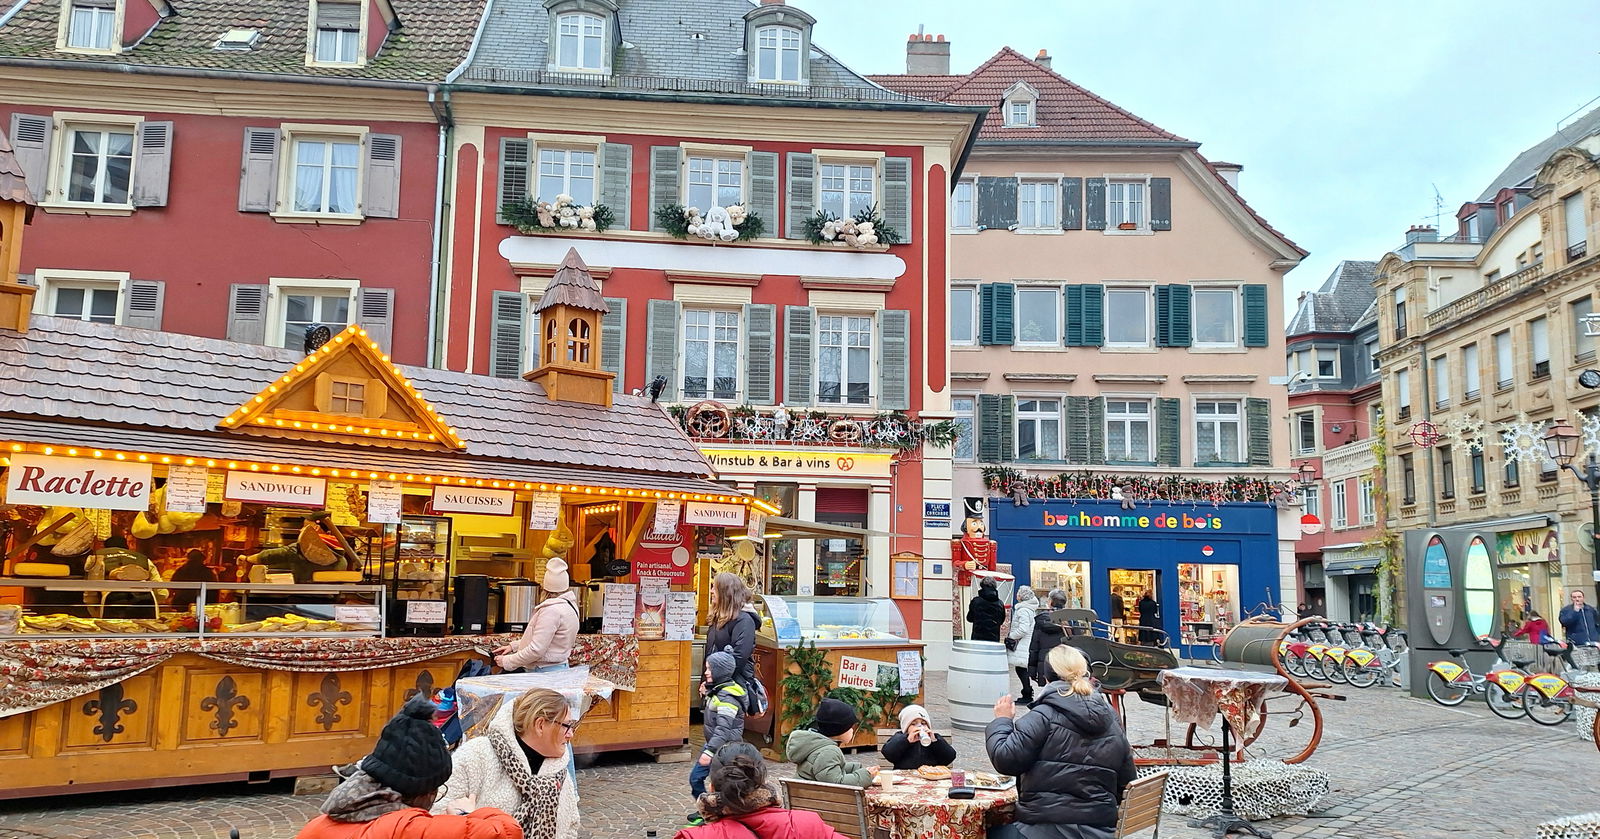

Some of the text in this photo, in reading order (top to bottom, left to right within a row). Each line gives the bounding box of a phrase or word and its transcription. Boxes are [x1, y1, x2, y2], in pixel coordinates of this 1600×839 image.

[759, 456, 768, 466] &
[772, 457, 792, 467] Bar
[795, 456, 802, 468] à
[806, 457, 830, 468] vins
[15, 466, 144, 498] Raclette
[239, 481, 312, 495] SANDWICH
[444, 494, 503, 506] SAUCISSES
[693, 509, 737, 519] SANDWICH
[1154, 512, 1178, 528] de
[1182, 513, 1222, 529] bois
[636, 561, 672, 570] Pain artisanal,
[842, 659, 859, 671] Bar
